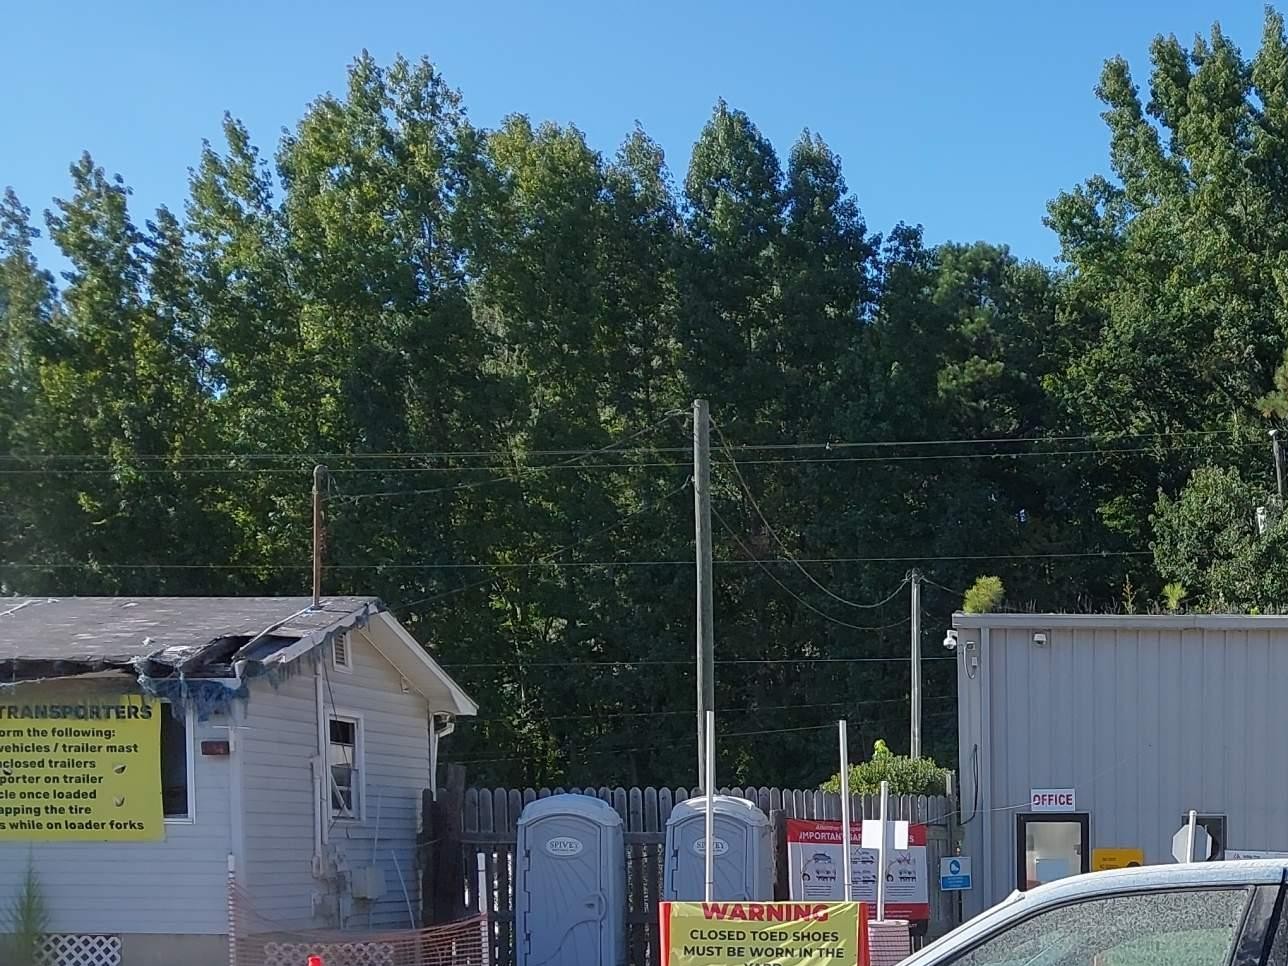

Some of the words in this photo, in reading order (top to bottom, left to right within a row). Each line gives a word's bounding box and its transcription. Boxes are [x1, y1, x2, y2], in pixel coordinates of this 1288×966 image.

[27, 727, 49, 738] the
[51, 727, 116, 740] following:
[53, 742, 59, 753] /
[62, 742, 102, 753] trailer
[106, 743, 139, 753] mast
[0, 758, 45, 769] closed
[48, 758, 96, 769] trailers
[44, 776, 60, 784] on
[63, 773, 104, 784] trailer
[19, 791, 50, 800] once
[53, 788, 97, 800] loaded
[1033, 794, 1073, 806] OFFICE
[44, 804, 66, 815] the
[69, 804, 92, 815] tire
[9, 819, 43, 830] while
[46, 821, 62, 830] on
[65, 819, 106, 830] loader
[110, 819, 145, 830] forks
[702, 902, 829, 923] WARNING
[690, 929, 746, 941] CLOSED
[749, 930, 788, 942] TOED
[792, 930, 839, 942] SHOES
[683, 945, 723, 957] MUST
[727, 946, 745, 957] BE
[749, 947, 795, 958] WORN
[798, 947, 814, 958] IN
[816, 947, 845, 959] THE
